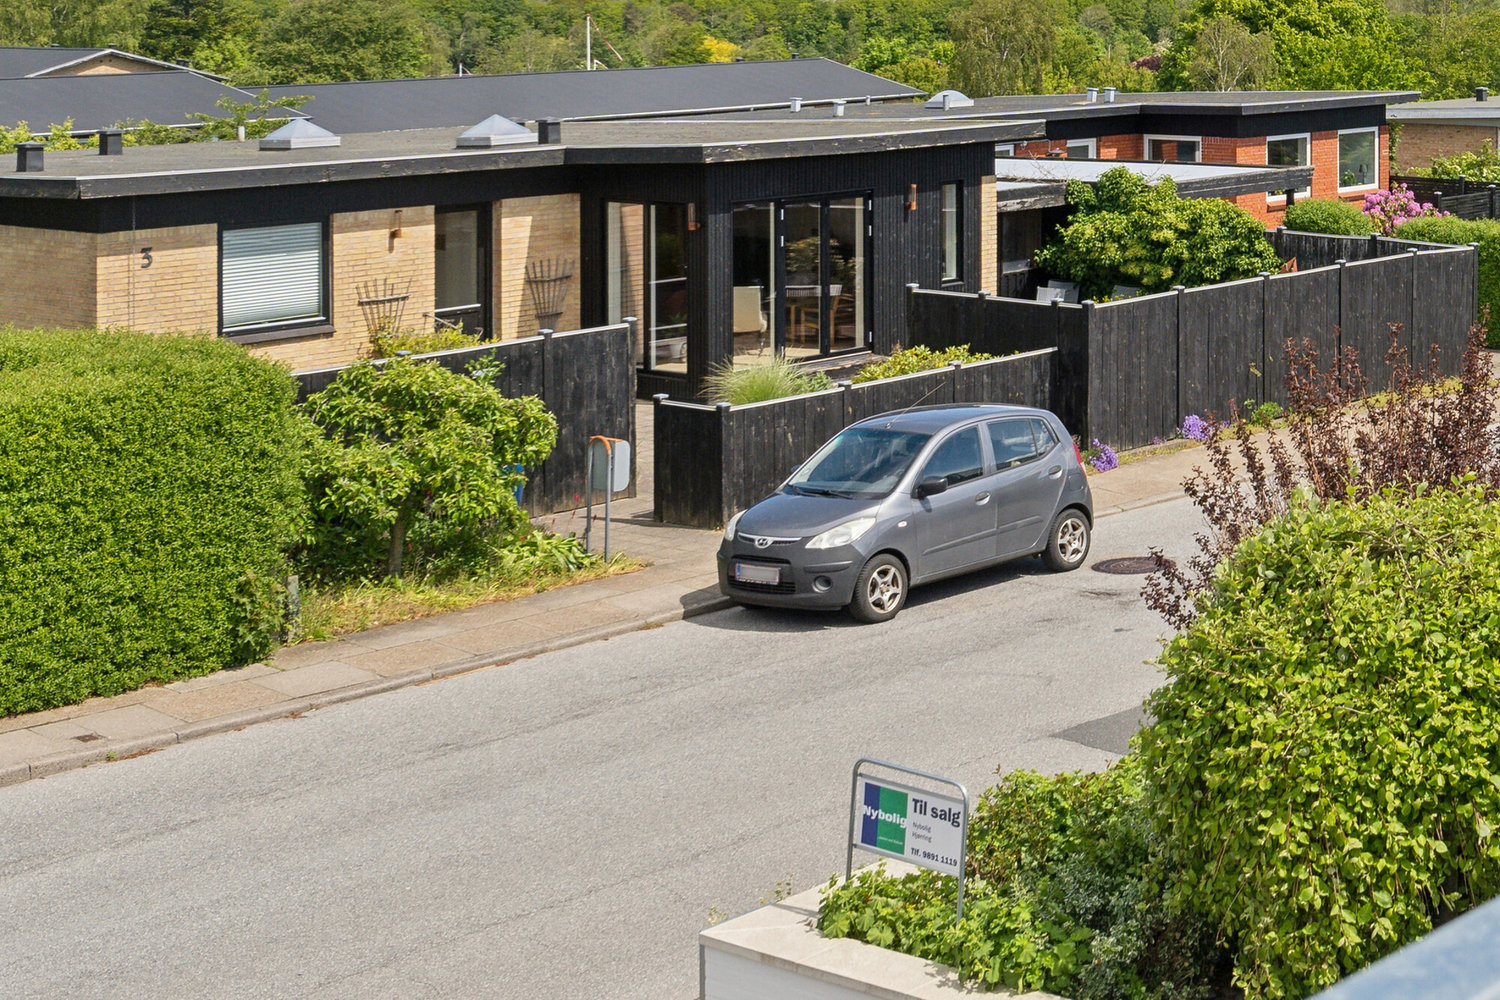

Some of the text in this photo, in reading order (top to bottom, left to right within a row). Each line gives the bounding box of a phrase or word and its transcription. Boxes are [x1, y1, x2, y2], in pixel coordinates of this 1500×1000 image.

[140, 247, 153, 268] 3
[863, 805, 907, 828] Nybolig
[912, 798, 961, 828] Til salg
[922, 850, 939, 862] 9891
